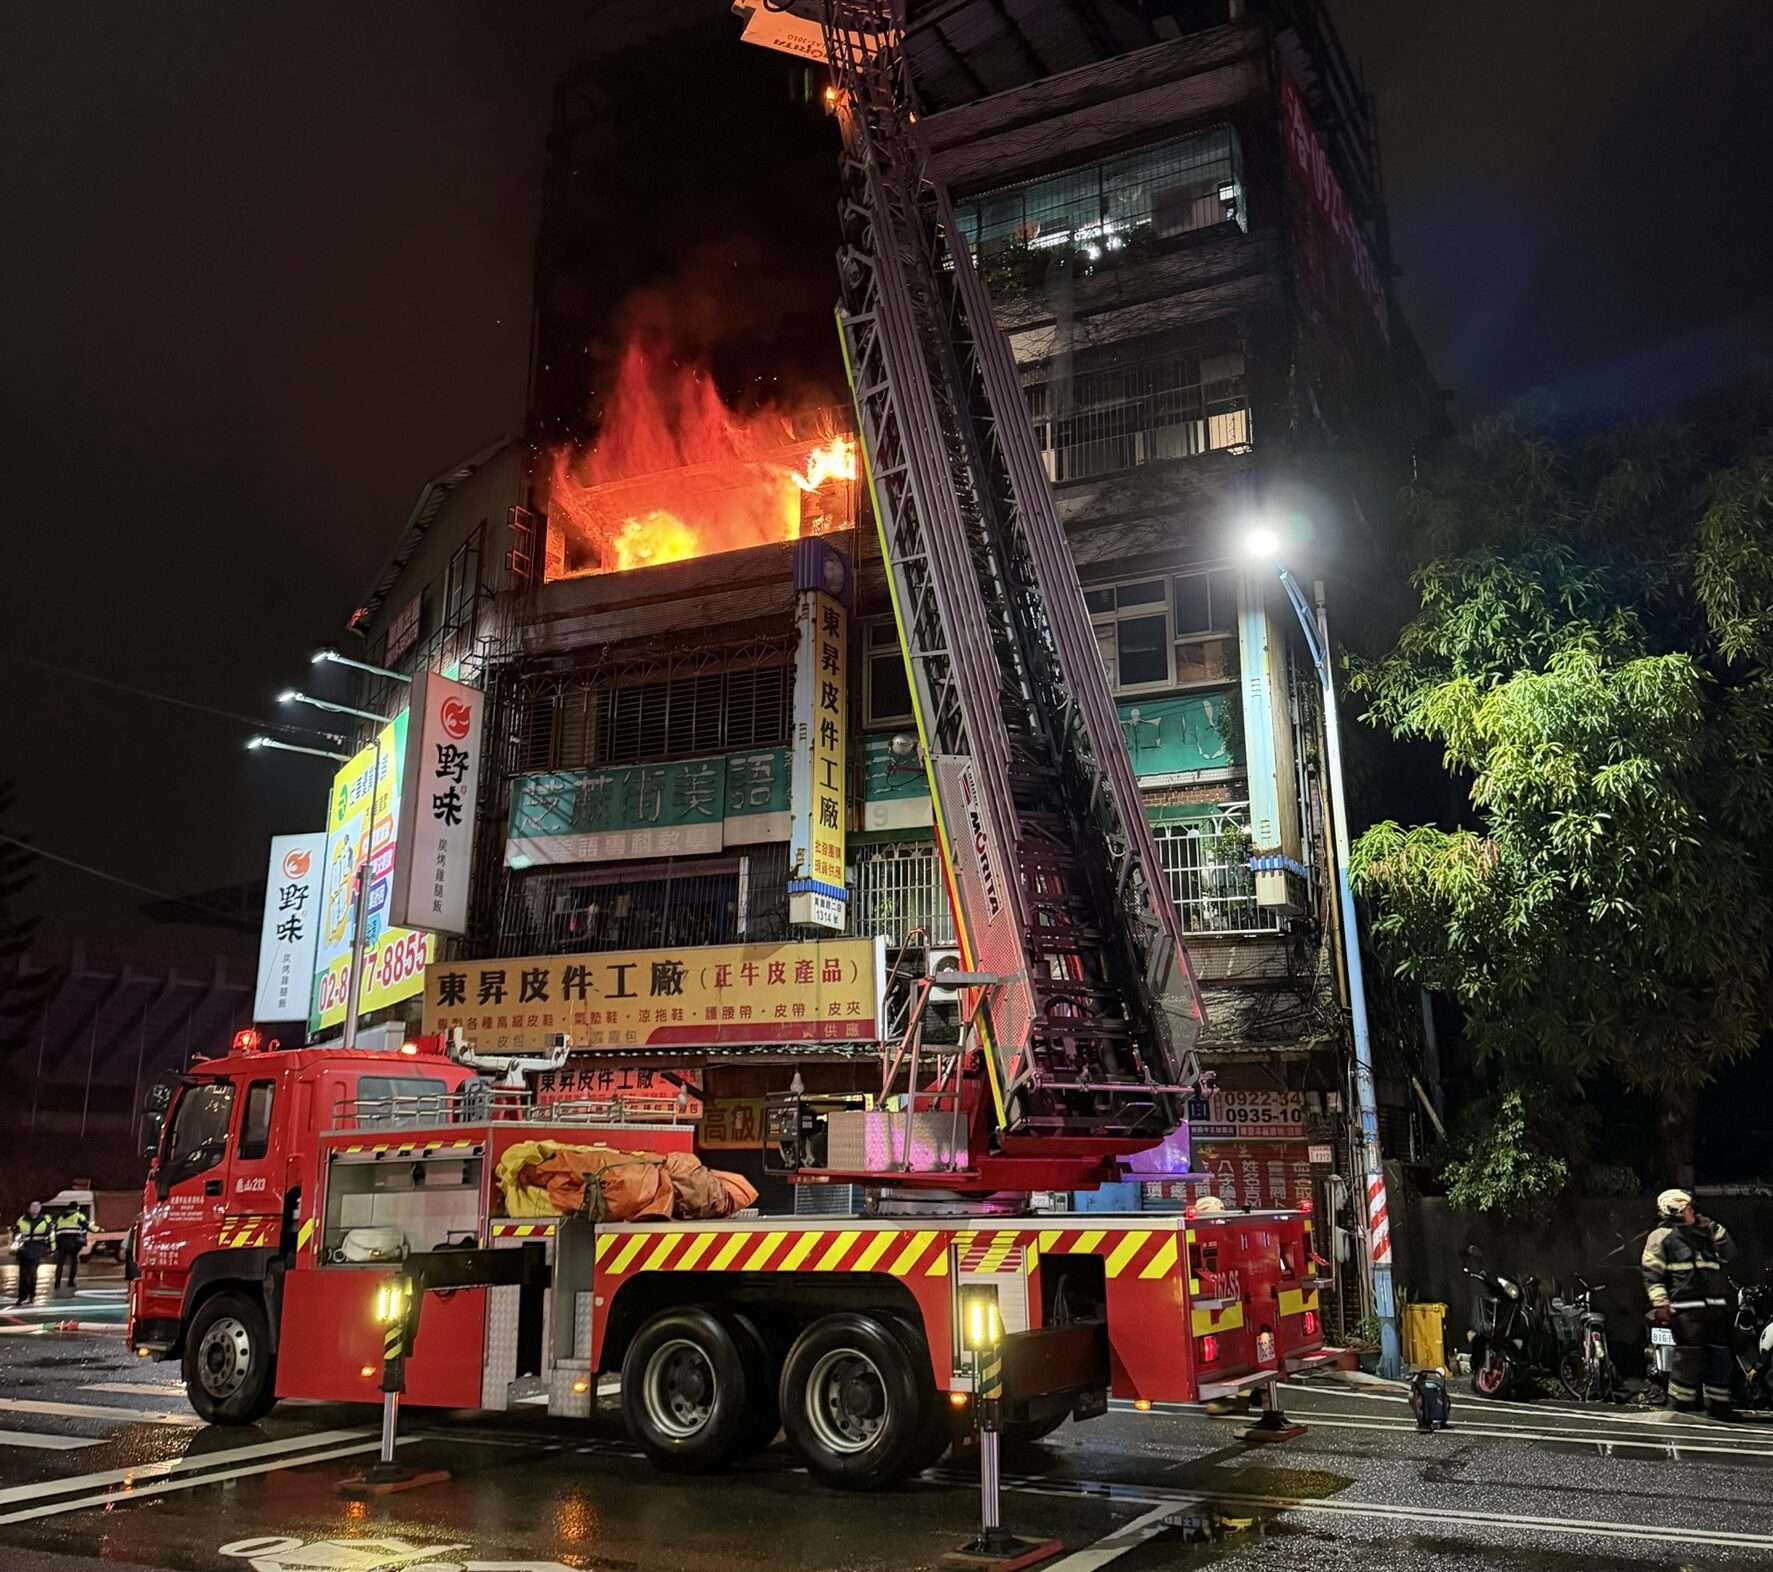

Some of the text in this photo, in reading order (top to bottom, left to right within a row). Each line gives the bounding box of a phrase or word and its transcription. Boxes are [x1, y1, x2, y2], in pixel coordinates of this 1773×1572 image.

[819, 606, 841, 830] 東昇皮件工廠
[432, 743, 469, 827] 野味
[969, 811, 1000, 915] MORITA
[276, 883, 310, 944] 野味
[437, 960, 687, 1007] 東昇皮件工廠
[540, 1068, 655, 1092] 東昇皮件工廠
[1225, 1092, 1301, 1106] 0922-34
[1226, 1108, 1302, 1123] 0935-10
